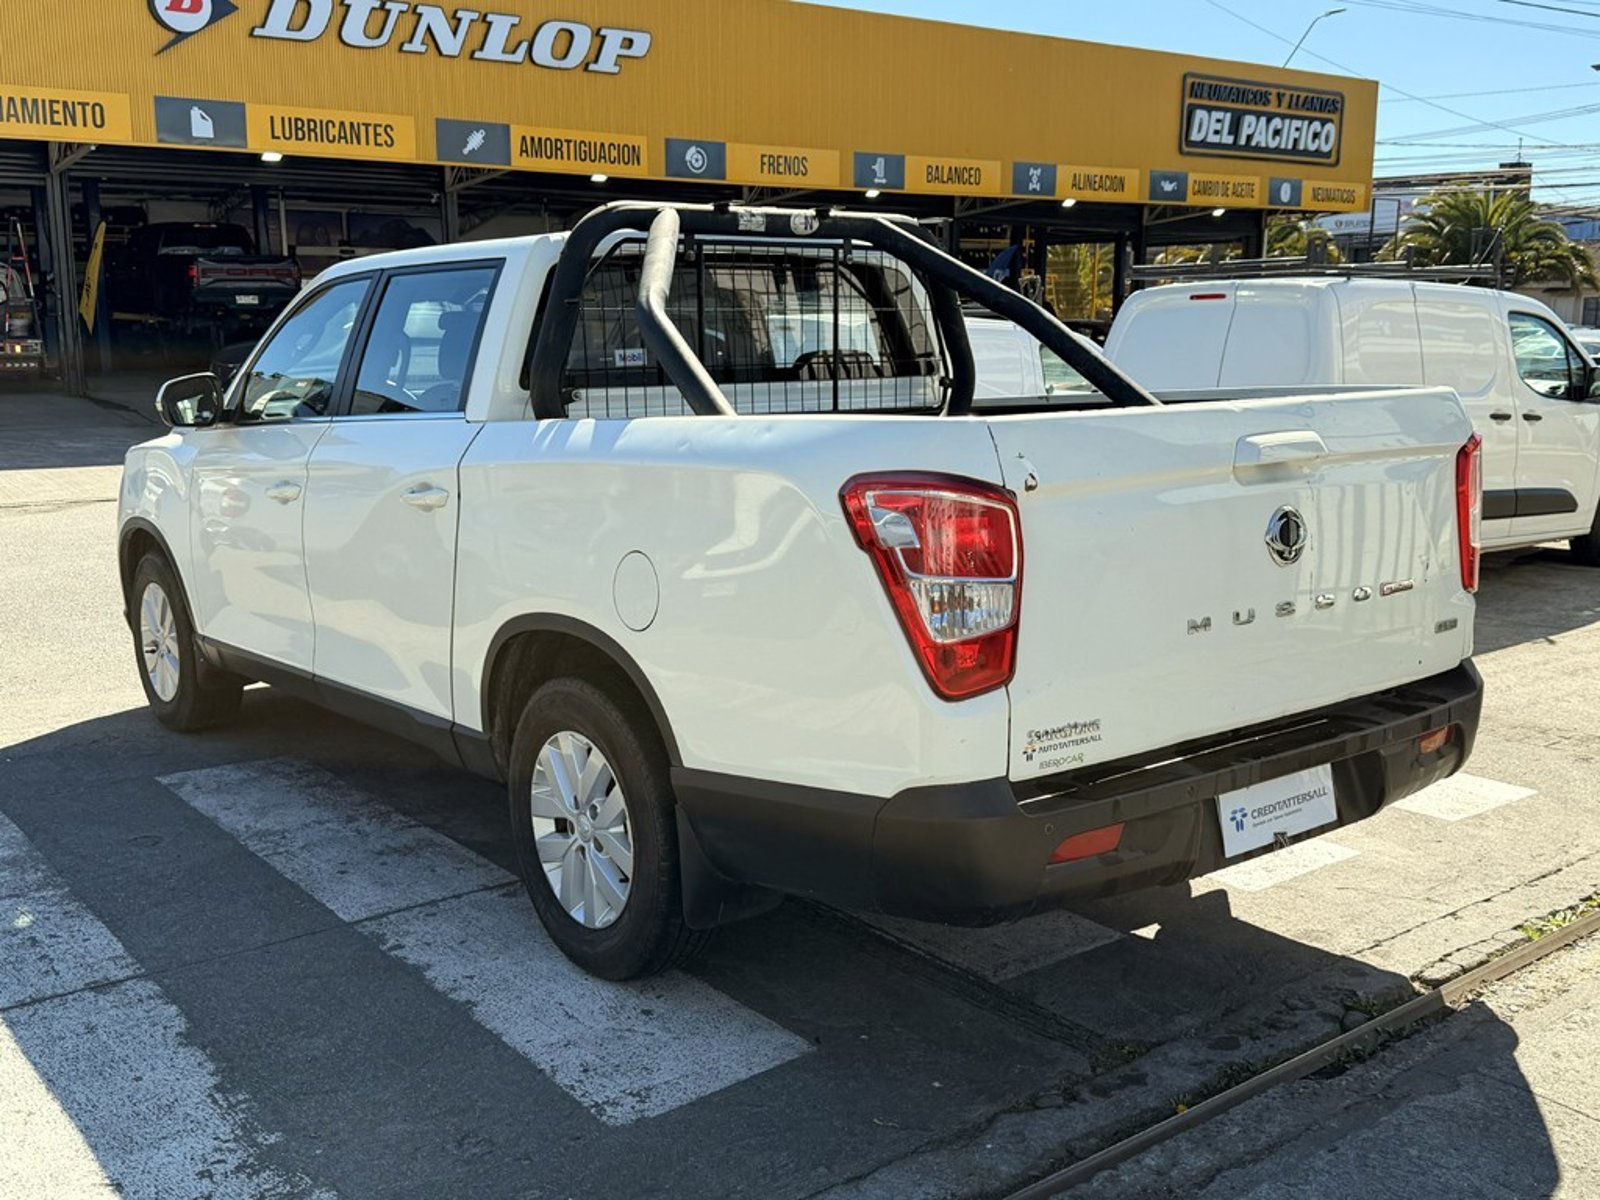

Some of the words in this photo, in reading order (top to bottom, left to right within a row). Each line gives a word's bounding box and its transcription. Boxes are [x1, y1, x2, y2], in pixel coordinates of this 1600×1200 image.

[249, 0, 652, 75] DUNLOP
[1190, 81, 1271, 106] NEUMATICOS
[1276, 91, 1286, 108] Y
[1288, 93, 1340, 113] LLANTAS
[269, 115, 395, 147] LUBRICANTES
[1189, 109, 1234, 144] DEL
[1238, 114, 1336, 152] PACIFICO
[519, 135, 641, 166] AMORTIGUACION
[760, 154, 809, 177] FRENOS
[926, 165, 981, 186] BALANCEO
[1071, 173, 1126, 192] ALINEACION
[1192, 179, 1219, 197] CAMBIO
[1220, 181, 1230, 197] DE
[1231, 182, 1255, 199] ACEITE
[1312, 187, 1356, 204] NEUMATICOS
[1187, 585, 1372, 635] MUSSO
[1251, 787, 1328, 819] CREDITATTERSALL
